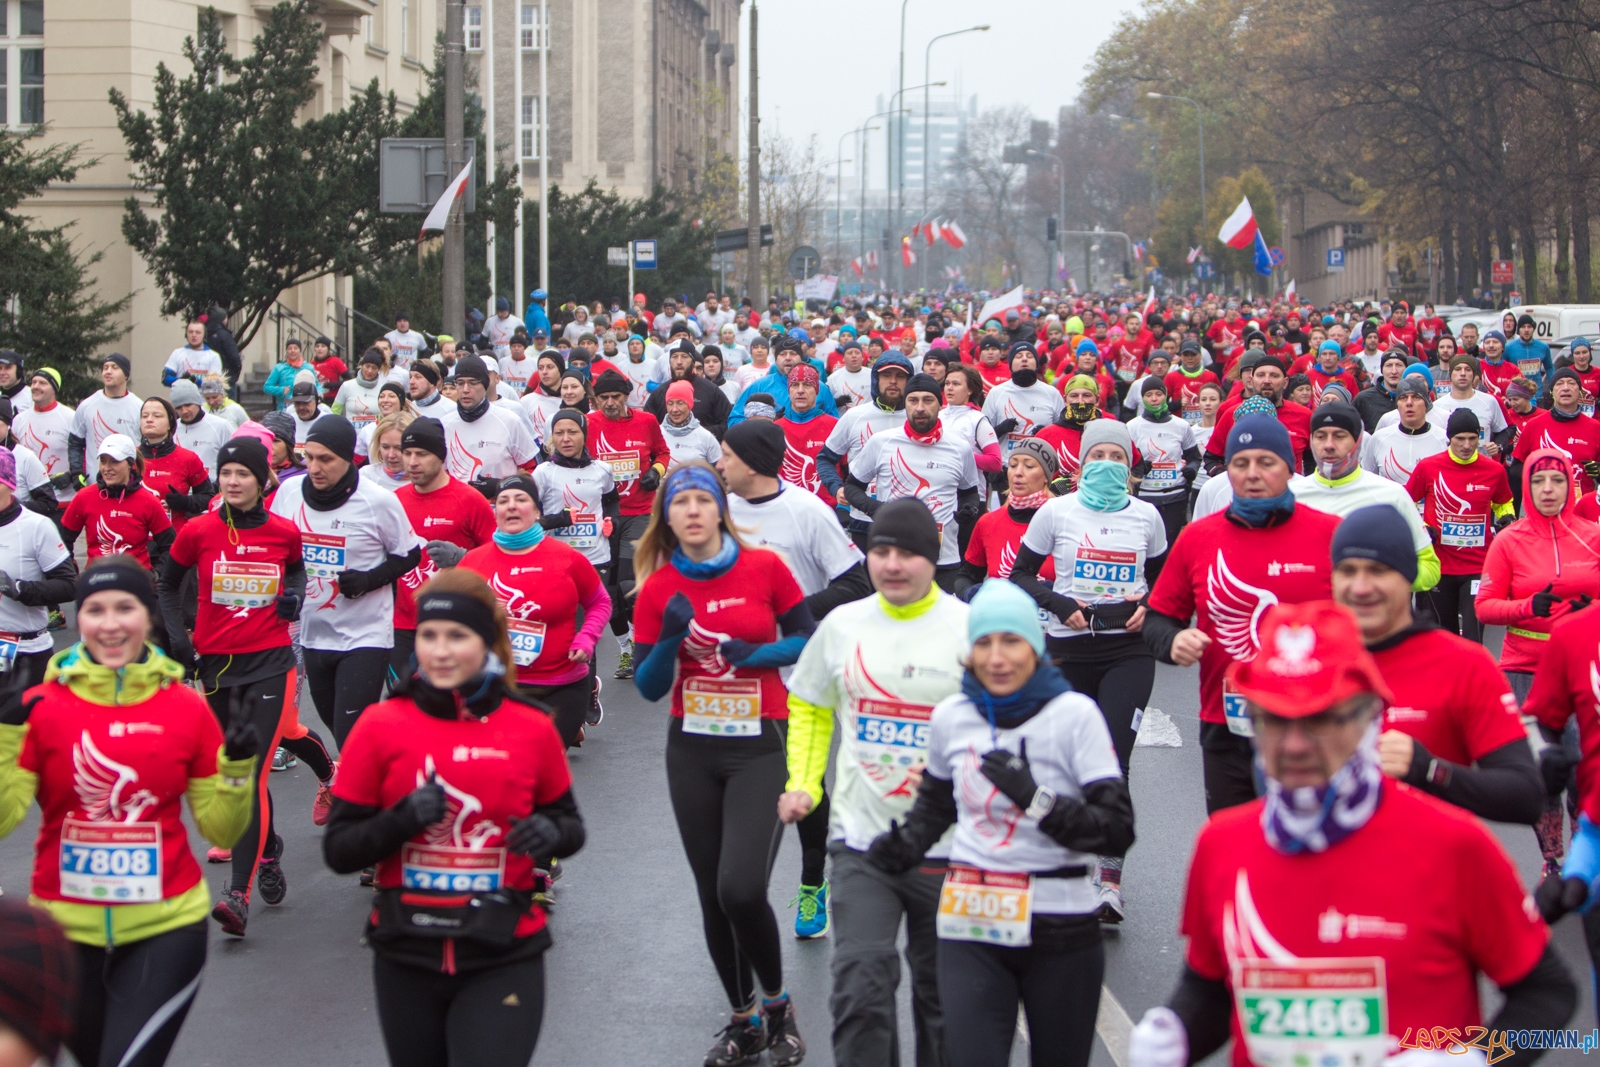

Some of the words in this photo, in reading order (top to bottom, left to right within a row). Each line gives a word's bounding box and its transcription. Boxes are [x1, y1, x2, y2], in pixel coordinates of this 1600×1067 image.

[1147, 469, 1175, 479] 4565
[559, 524, 594, 536] 2020
[1448, 524, 1482, 536] 7823
[1082, 562, 1131, 581] 9018
[221, 578, 272, 594] 9967
[509, 632, 537, 651] 49
[693, 695, 753, 717] 3439
[864, 719, 932, 749] 5945
[71, 848, 152, 875] 7808
[952, 891, 1021, 920] 7905
[1258, 997, 1372, 1036] 2466
